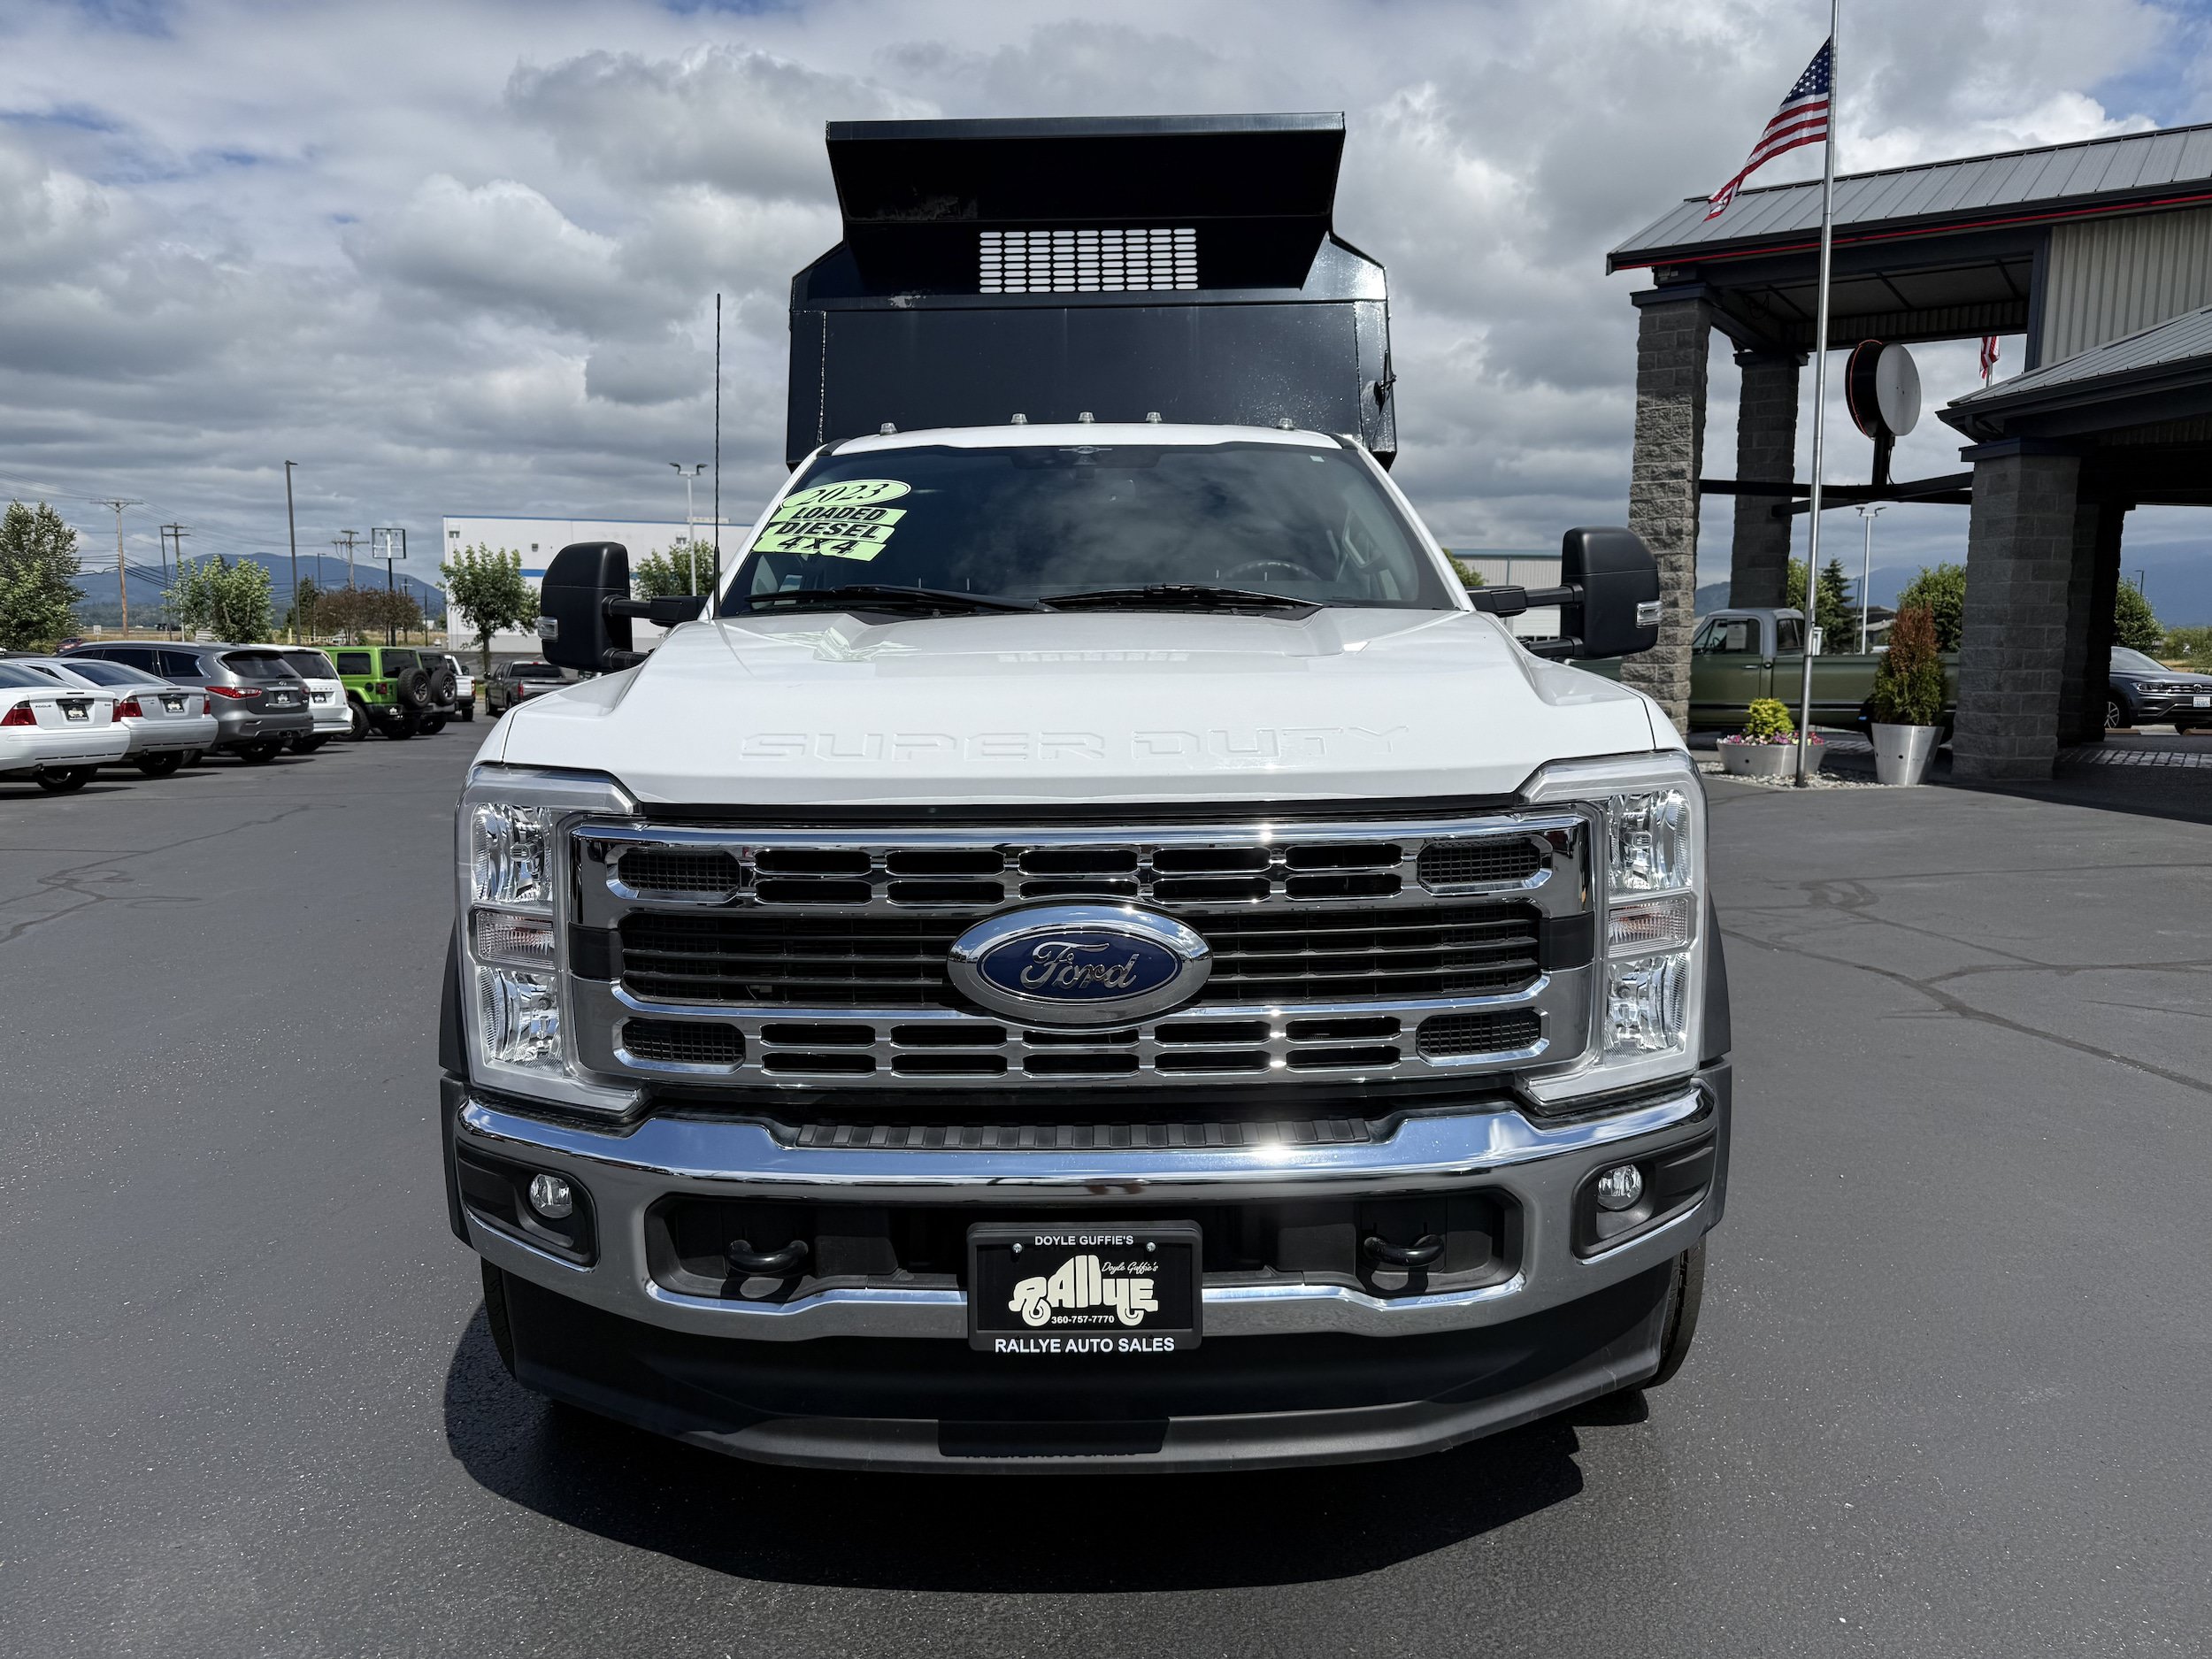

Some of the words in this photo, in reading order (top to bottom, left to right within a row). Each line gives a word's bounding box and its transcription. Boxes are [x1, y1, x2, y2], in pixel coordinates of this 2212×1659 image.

[797, 483, 889, 505] 2023
[791, 507, 887, 520] LOADED
[774, 522, 880, 539] DIESEL
[739, 733, 1105, 762] SUPER
[1131, 726, 1409, 762] DUTY
[1019, 941, 1140, 989] Ford
[1034, 1235, 1076, 1246] DOYLE
[1079, 1235, 1134, 1246] GUFFIE'S
[1101, 1261, 1125, 1275] Doyle
[1127, 1261, 1159, 1274] Guffie's
[1051, 1314, 1115, 1325] 360-757-7770
[995, 1338, 1061, 1353] RALLYE
[1064, 1338, 1114, 1353] AUTO
[1118, 1337, 1175, 1352] SALES
